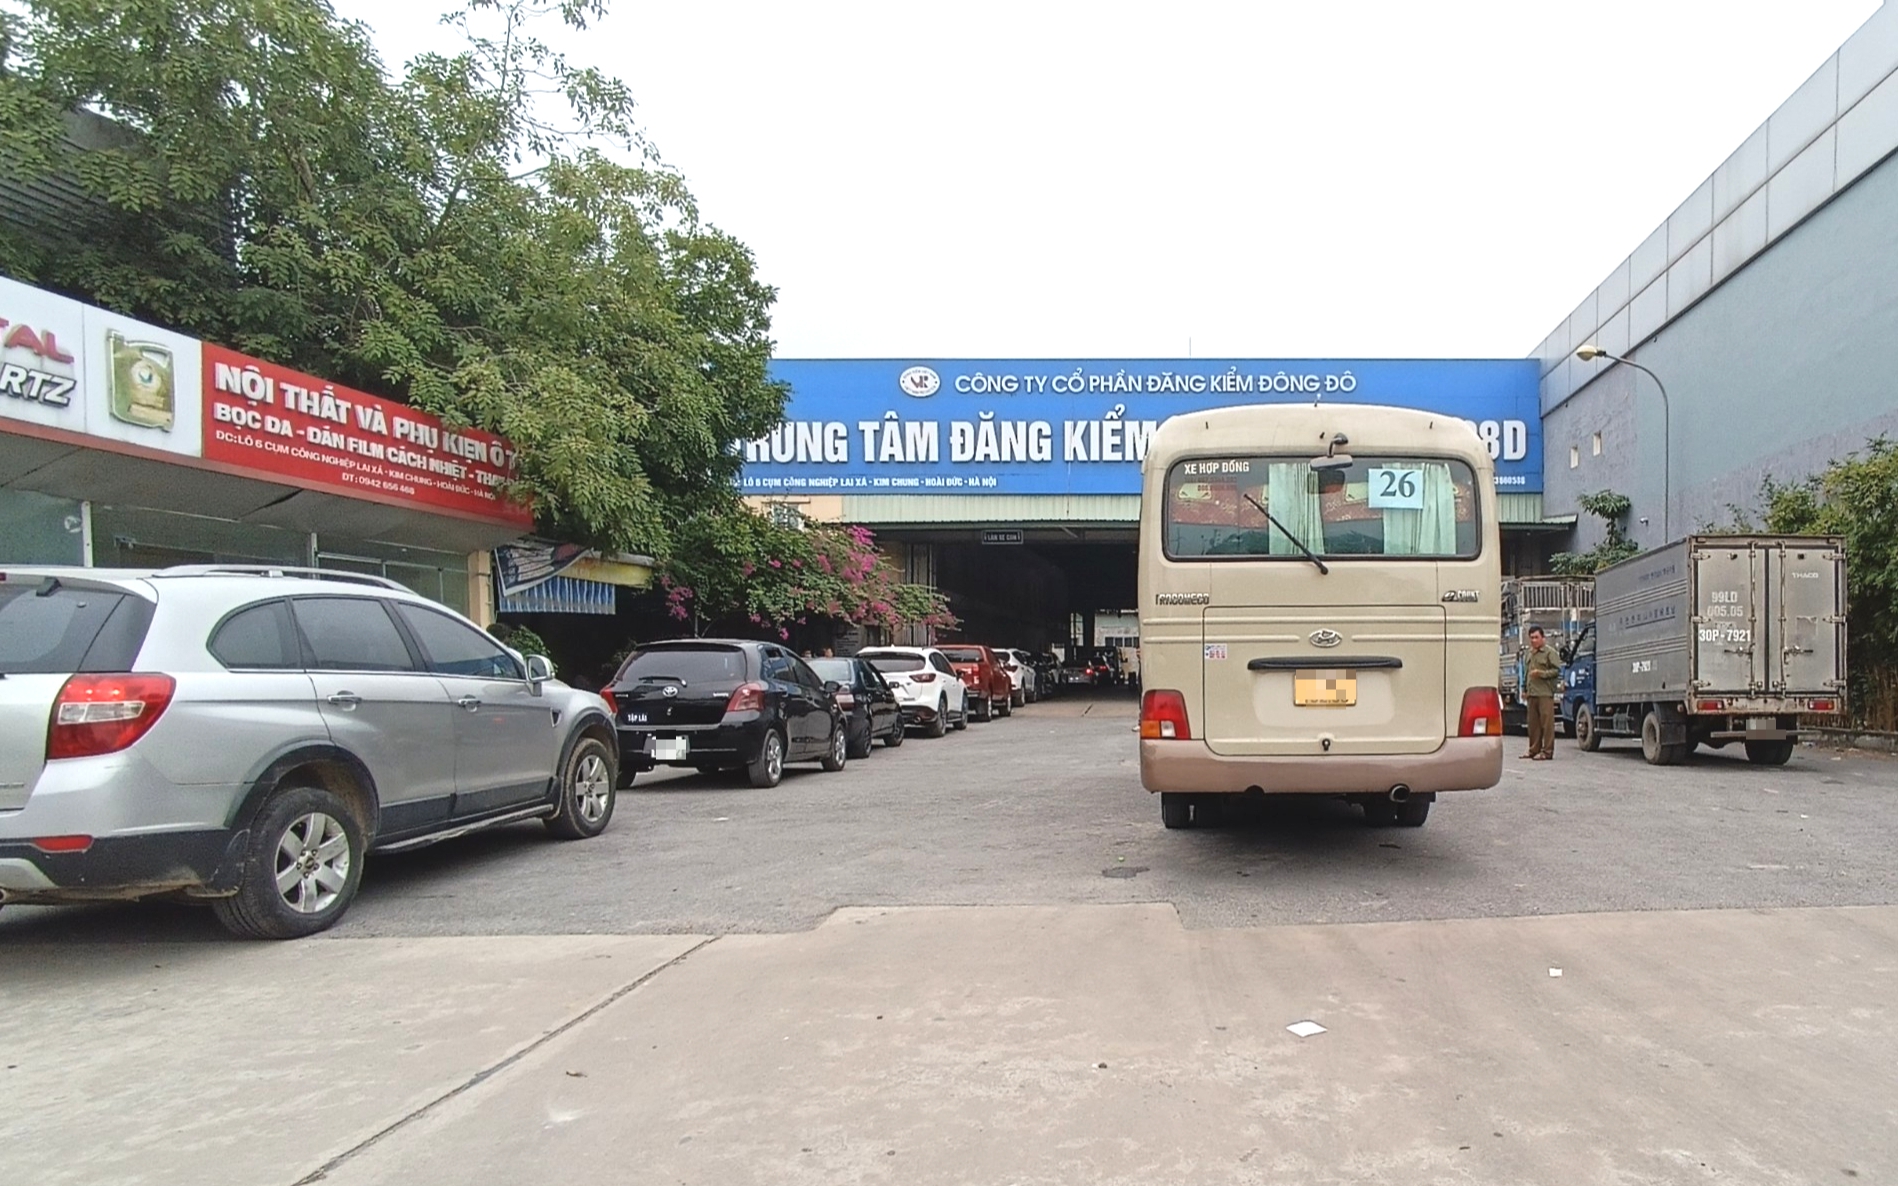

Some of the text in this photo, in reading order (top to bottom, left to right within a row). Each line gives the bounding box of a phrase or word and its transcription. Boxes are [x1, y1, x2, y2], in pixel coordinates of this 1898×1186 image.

[954, 371, 1019, 393] CÔNG
[1023, 375, 1048, 393] TY
[1051, 367, 1085, 393] CỔ
[1089, 368, 1142, 393] PHẦN
[1145, 371, 1206, 392] ĐĂNG
[1210, 366, 1254, 392] KIỂM
[1257, 371, 1321, 392] ĐÔNG
[1324, 370, 1357, 392] ĐÔ
[214, 362, 274, 407] NỘI
[279, 385, 352, 425] THẤT
[354, 404, 389, 436] VÀ
[392, 416, 438, 454] PHỤ
[489, 440, 505, 469] Ô
[213, 402, 262, 430] BỌC
[346, 436, 385, 460] FILM
[386, 445, 427, 471] CÁCH
[428, 458, 468, 481] NHIỆT
[728, 421, 848, 463] RUNG
[858, 410, 940, 463] TÂM
[949, 411, 1052, 463] ĐĂNG
[1063, 403, 1158, 463] KIỂM
[290, 446, 321, 462] CÔNG
[356, 462, 371, 473] LAI
[388, 469, 404, 480] KIM
[404, 473, 433, 486] CHUNG
[1184, 463, 1197, 475] XE
[743, 476, 754, 487] LÔ
[762, 478, 781, 489] CỤM
[783, 476, 807, 487] CÔNG
[808, 476, 839, 488] NGHIỆP
[840, 477, 854, 487] LAI
[873, 477, 890, 487] KIM
[891, 477, 920, 487] CHUNG
[968, 475, 980, 487] HÀ
[981, 475, 997, 489] NỘI
[1380, 470, 1416, 498] 26
[1711, 591, 1738, 603] 99LD
[1699, 629, 1751, 642] 30P-7921
